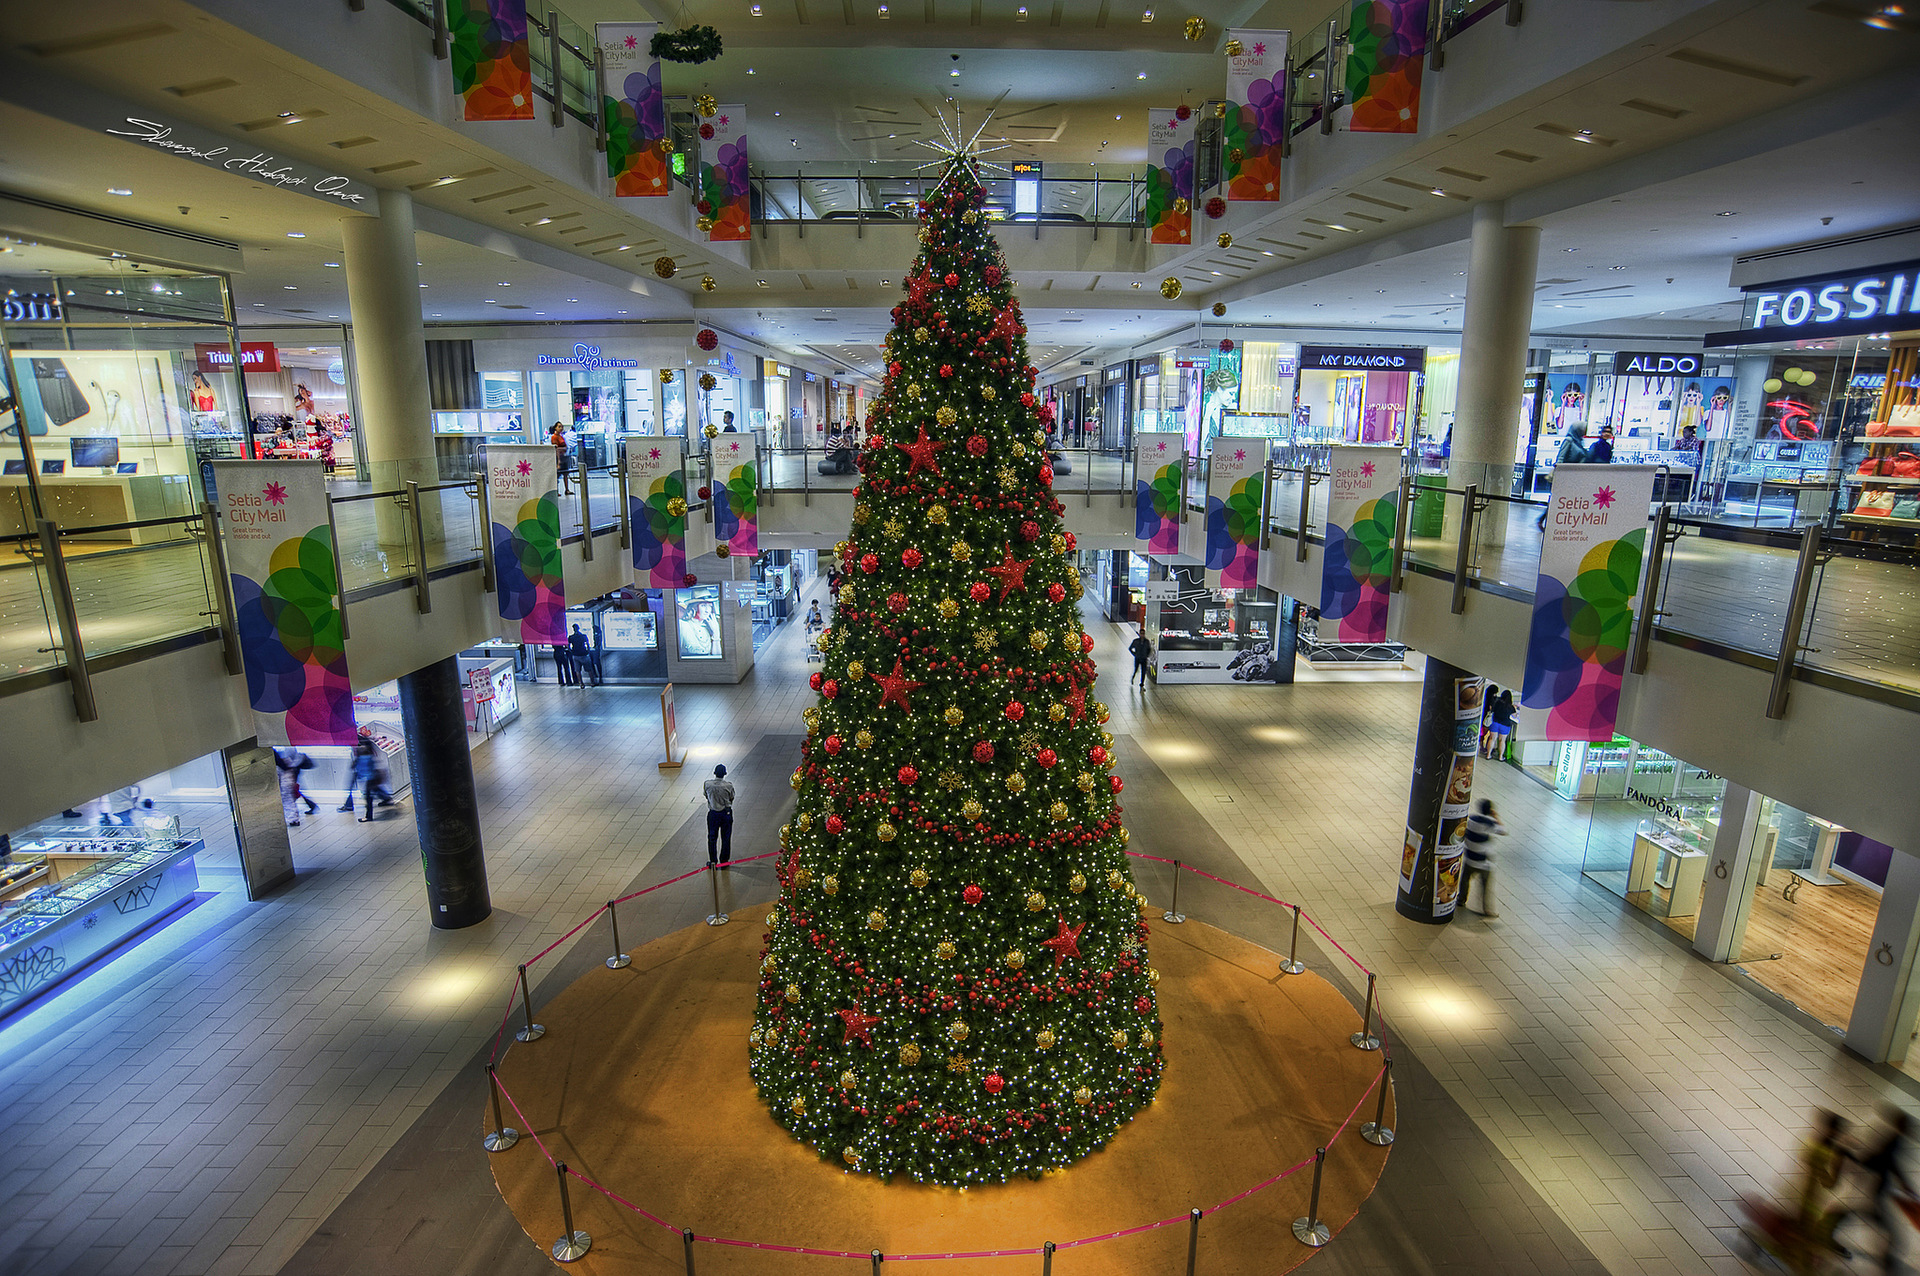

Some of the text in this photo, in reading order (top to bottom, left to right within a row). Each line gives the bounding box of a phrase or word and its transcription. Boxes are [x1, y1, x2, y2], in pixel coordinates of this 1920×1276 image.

[604, 42, 624, 50] Setia
[605, 52, 619, 61] City
[1240, 48, 1251, 56] tia
[1232, 58, 1263, 67] City Mall
[206, 351, 255, 364] Triuph
[1319, 354, 1405, 367] MY DIAMOND
[1626, 356, 1695, 373] ALDO
[631, 453, 649, 461] Setia
[1215, 454, 1233, 462] Setia
[631, 462, 645, 470] City
[1215, 462, 1229, 471] City
[493, 467, 516, 477] Setia
[1336, 468, 1359, 478] Setia
[494, 478, 531, 489] City Mall
[1335, 479, 1372, 491] City Mall
[227, 493, 262, 507] Setia
[1557, 496, 1590, 510] Setia
[230, 508, 287, 526] City Mall
[1555, 512, 1608, 529] City Mall
[1627, 786, 1681, 822] PANDORA
